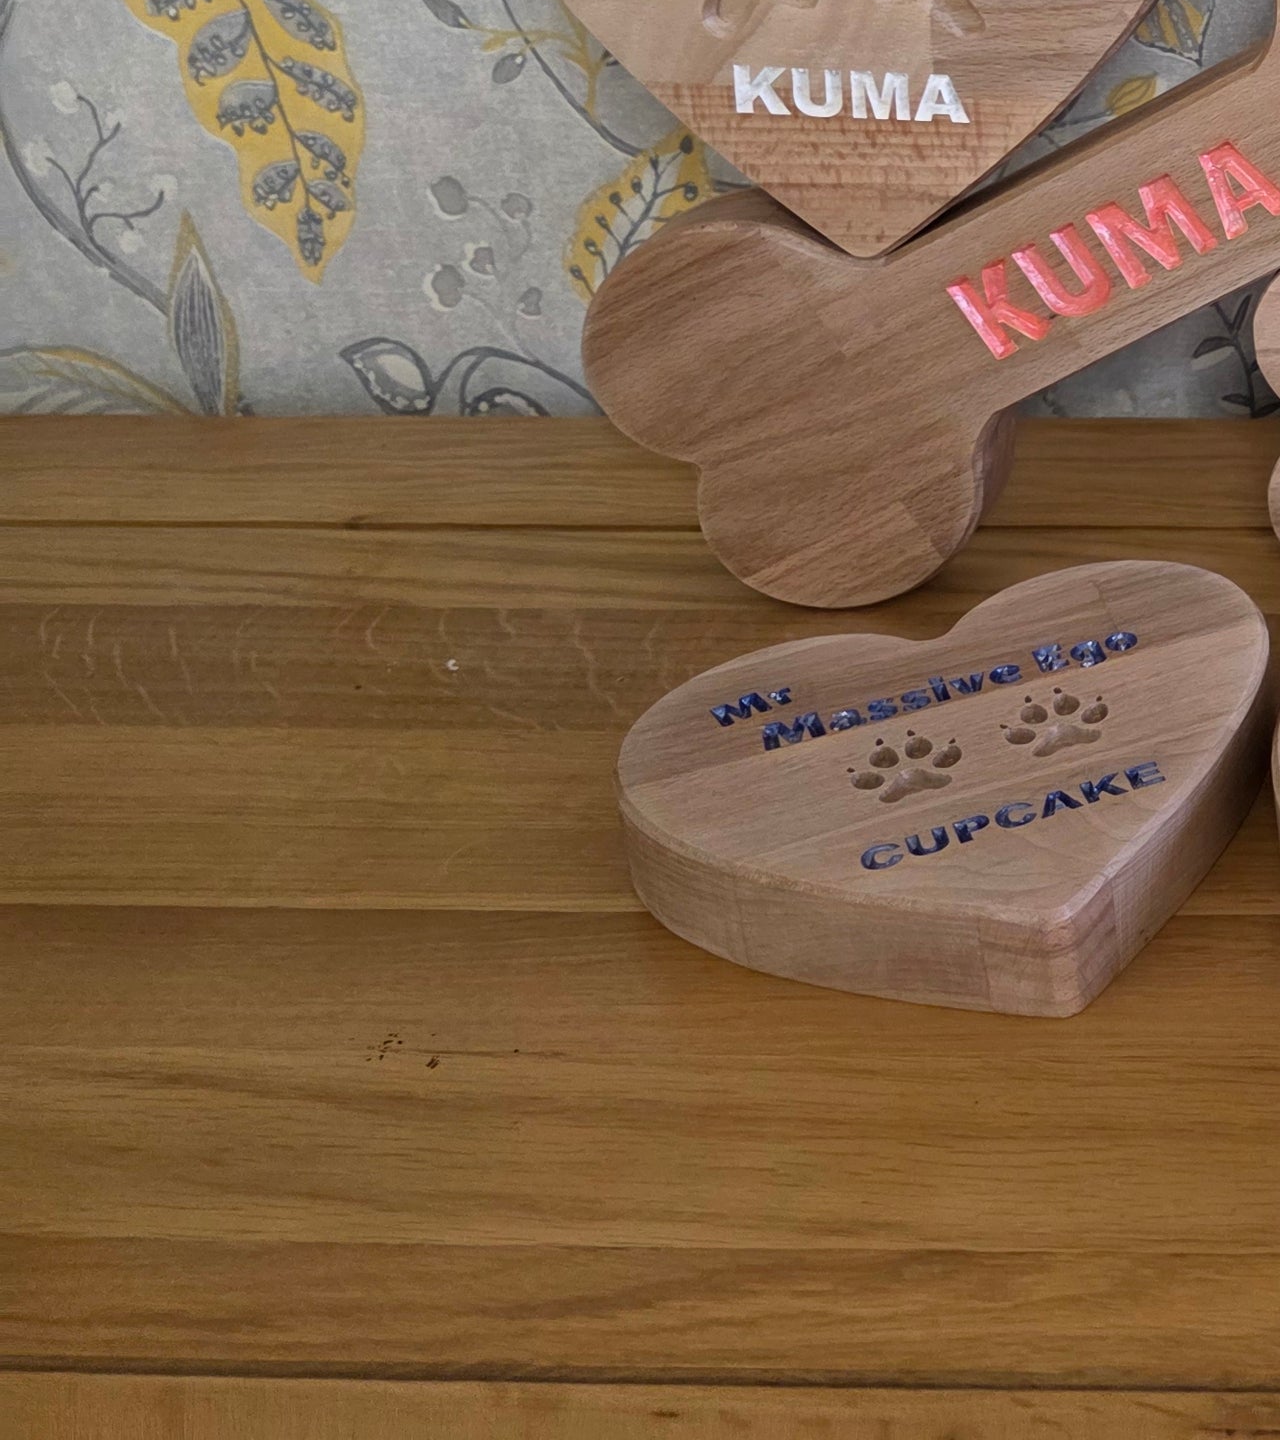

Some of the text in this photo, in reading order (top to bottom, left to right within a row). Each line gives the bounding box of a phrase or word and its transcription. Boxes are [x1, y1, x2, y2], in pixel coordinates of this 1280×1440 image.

[732, 64, 970, 124] KUMA
[710, 686, 792, 727] Mr
[762, 631, 1138, 751] Massive Ego
[860, 761, 1167, 870] CUPCAKE
